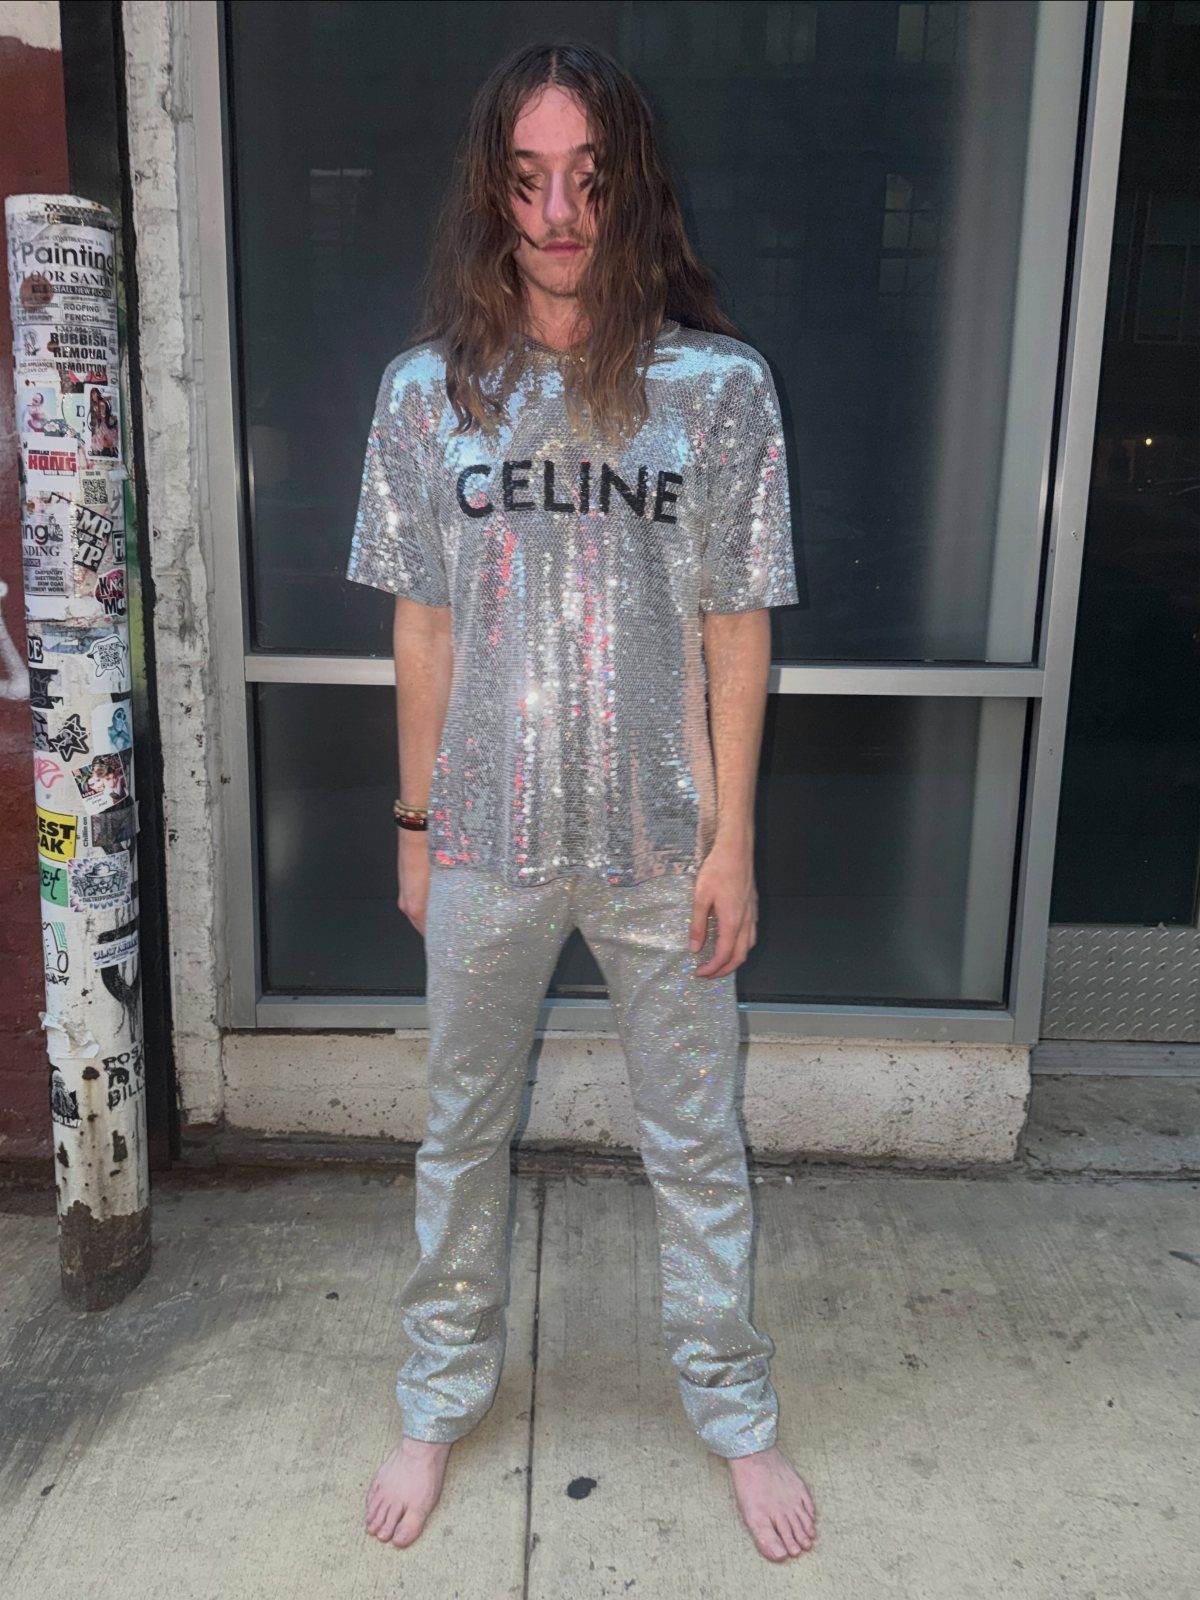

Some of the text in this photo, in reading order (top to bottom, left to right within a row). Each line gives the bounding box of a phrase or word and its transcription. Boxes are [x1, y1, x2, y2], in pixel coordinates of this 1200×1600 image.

[21, 241, 115, 277] Painting
[53, 347, 108, 361] REMOVAL
[28, 454, 77, 472] KONG
[455, 457, 684, 525] CELINE
